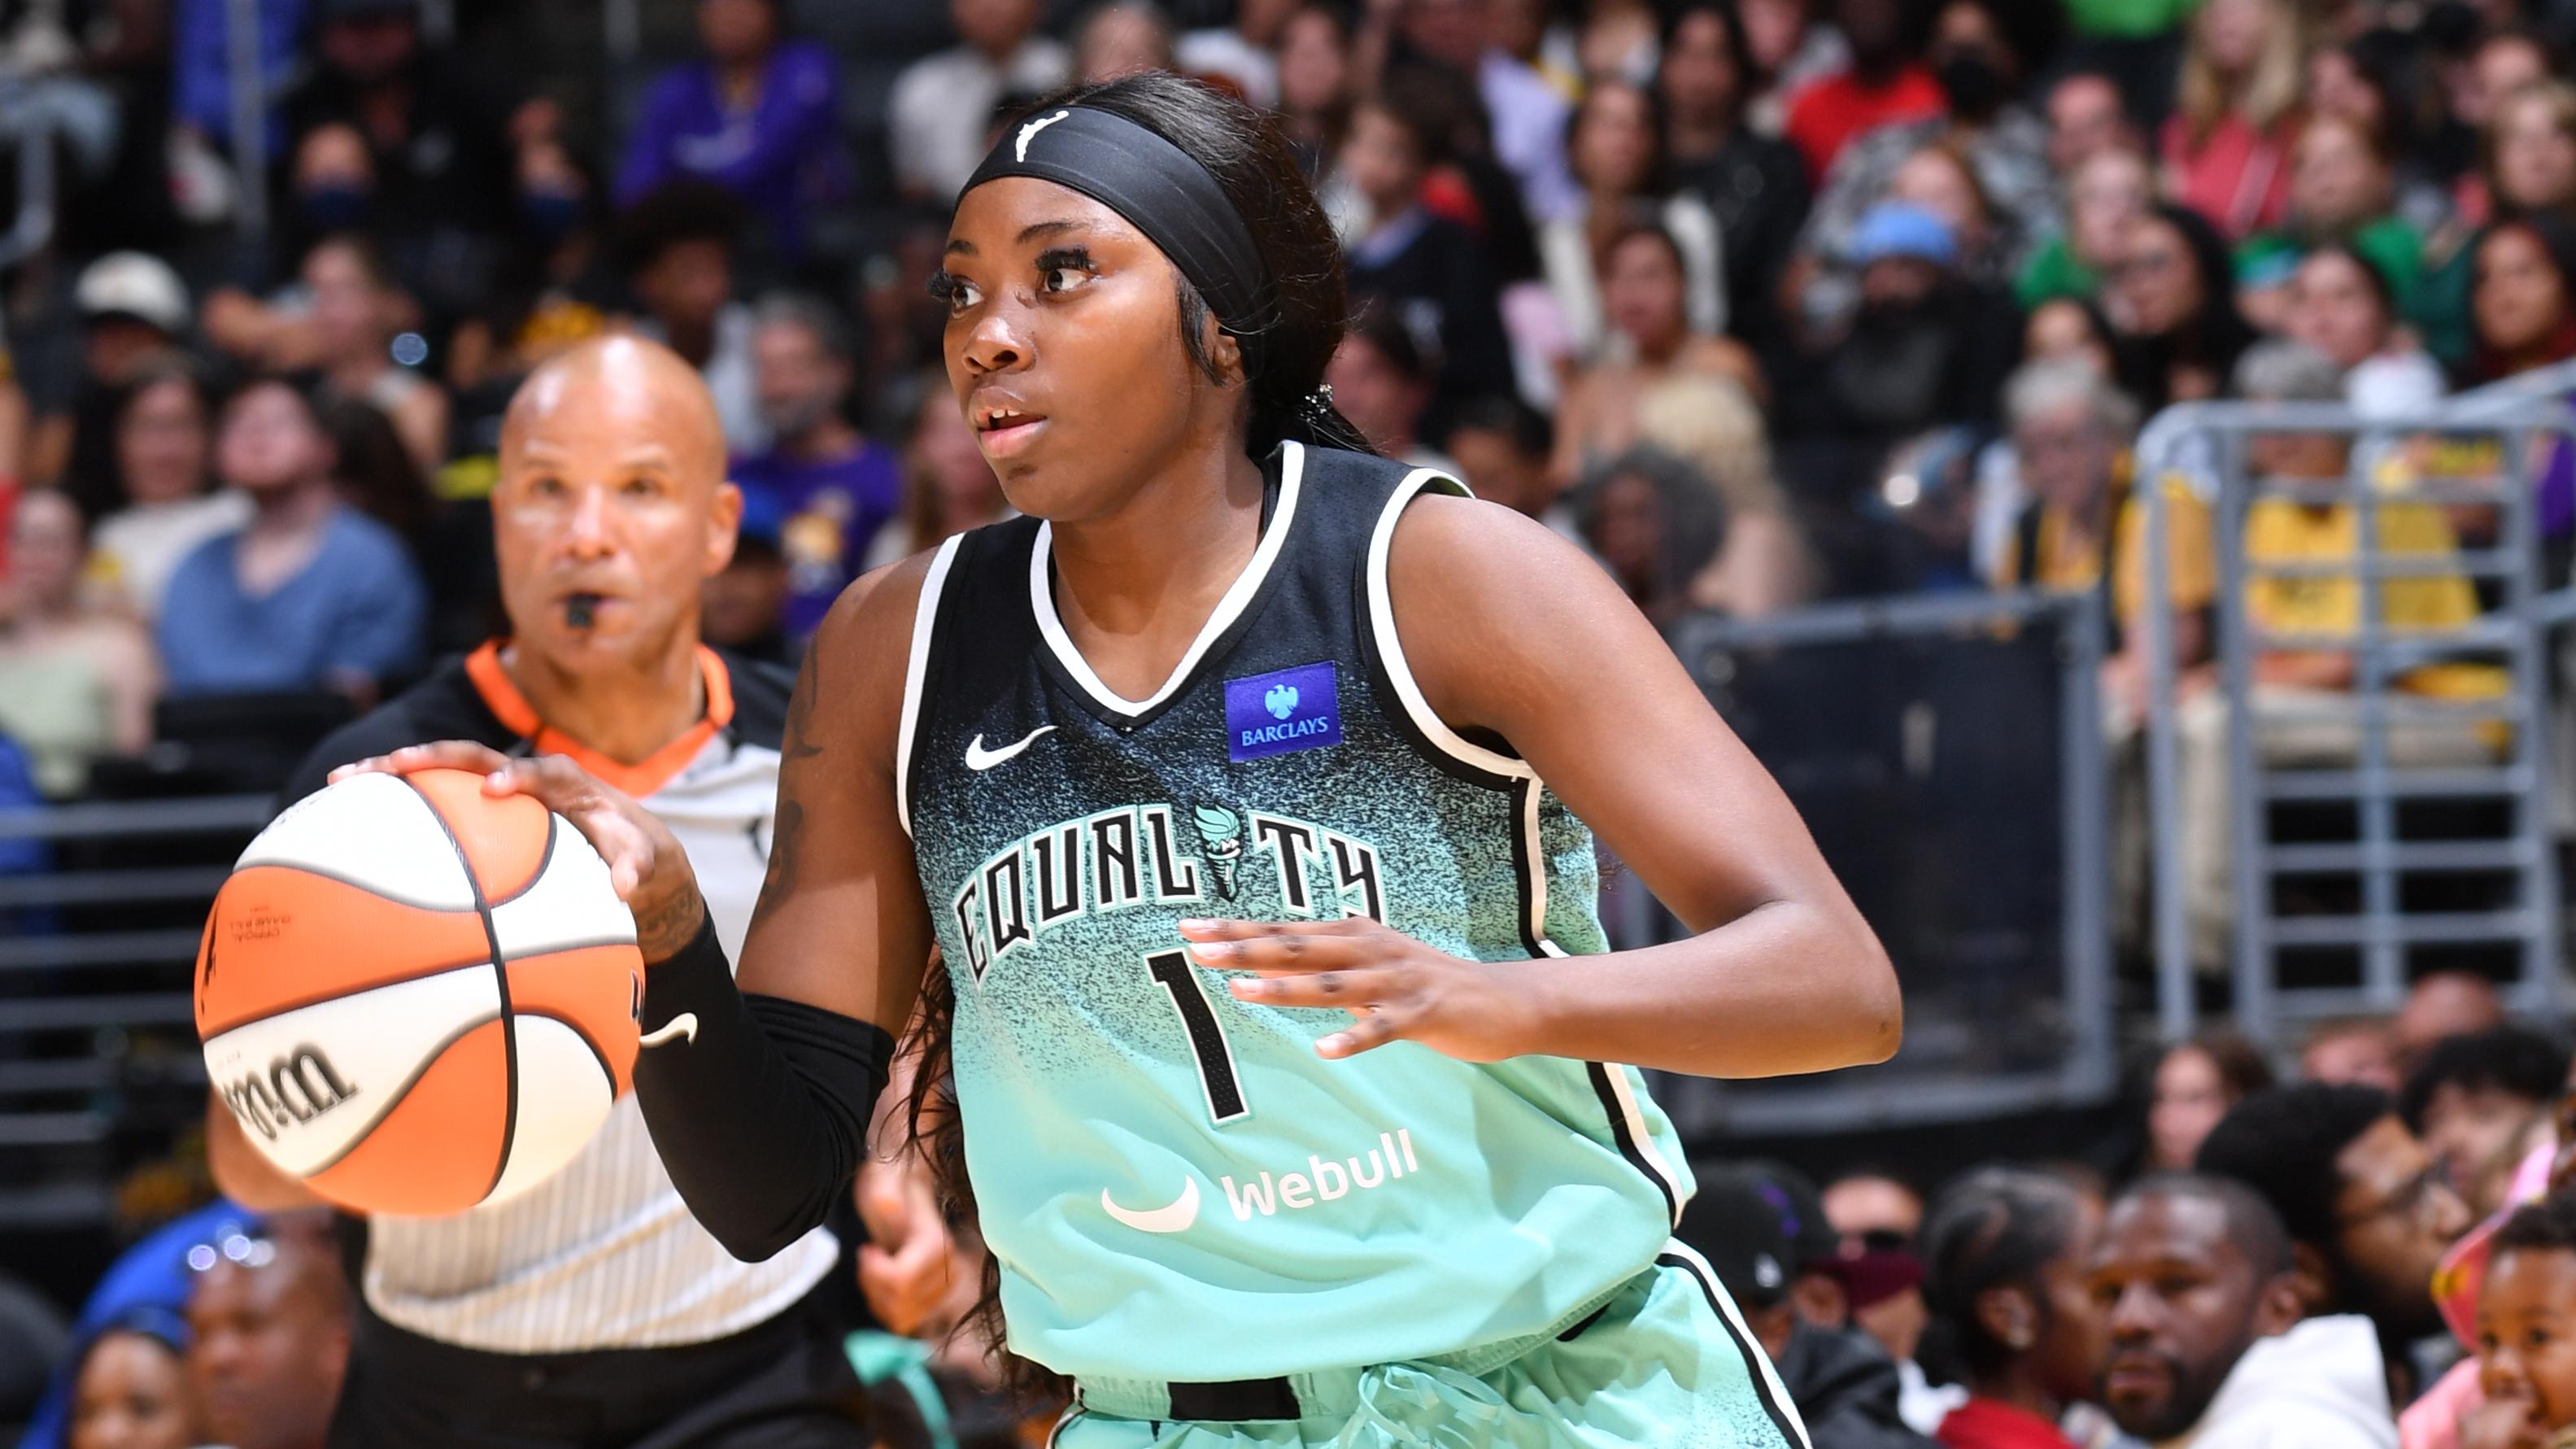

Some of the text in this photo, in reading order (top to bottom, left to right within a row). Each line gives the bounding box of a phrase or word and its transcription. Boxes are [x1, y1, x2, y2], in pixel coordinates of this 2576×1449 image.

[1241, 716, 1328, 747] BARCLAYS
[1142, 946, 1250, 1124] 1
[1220, 1128, 1418, 1221] Webull
